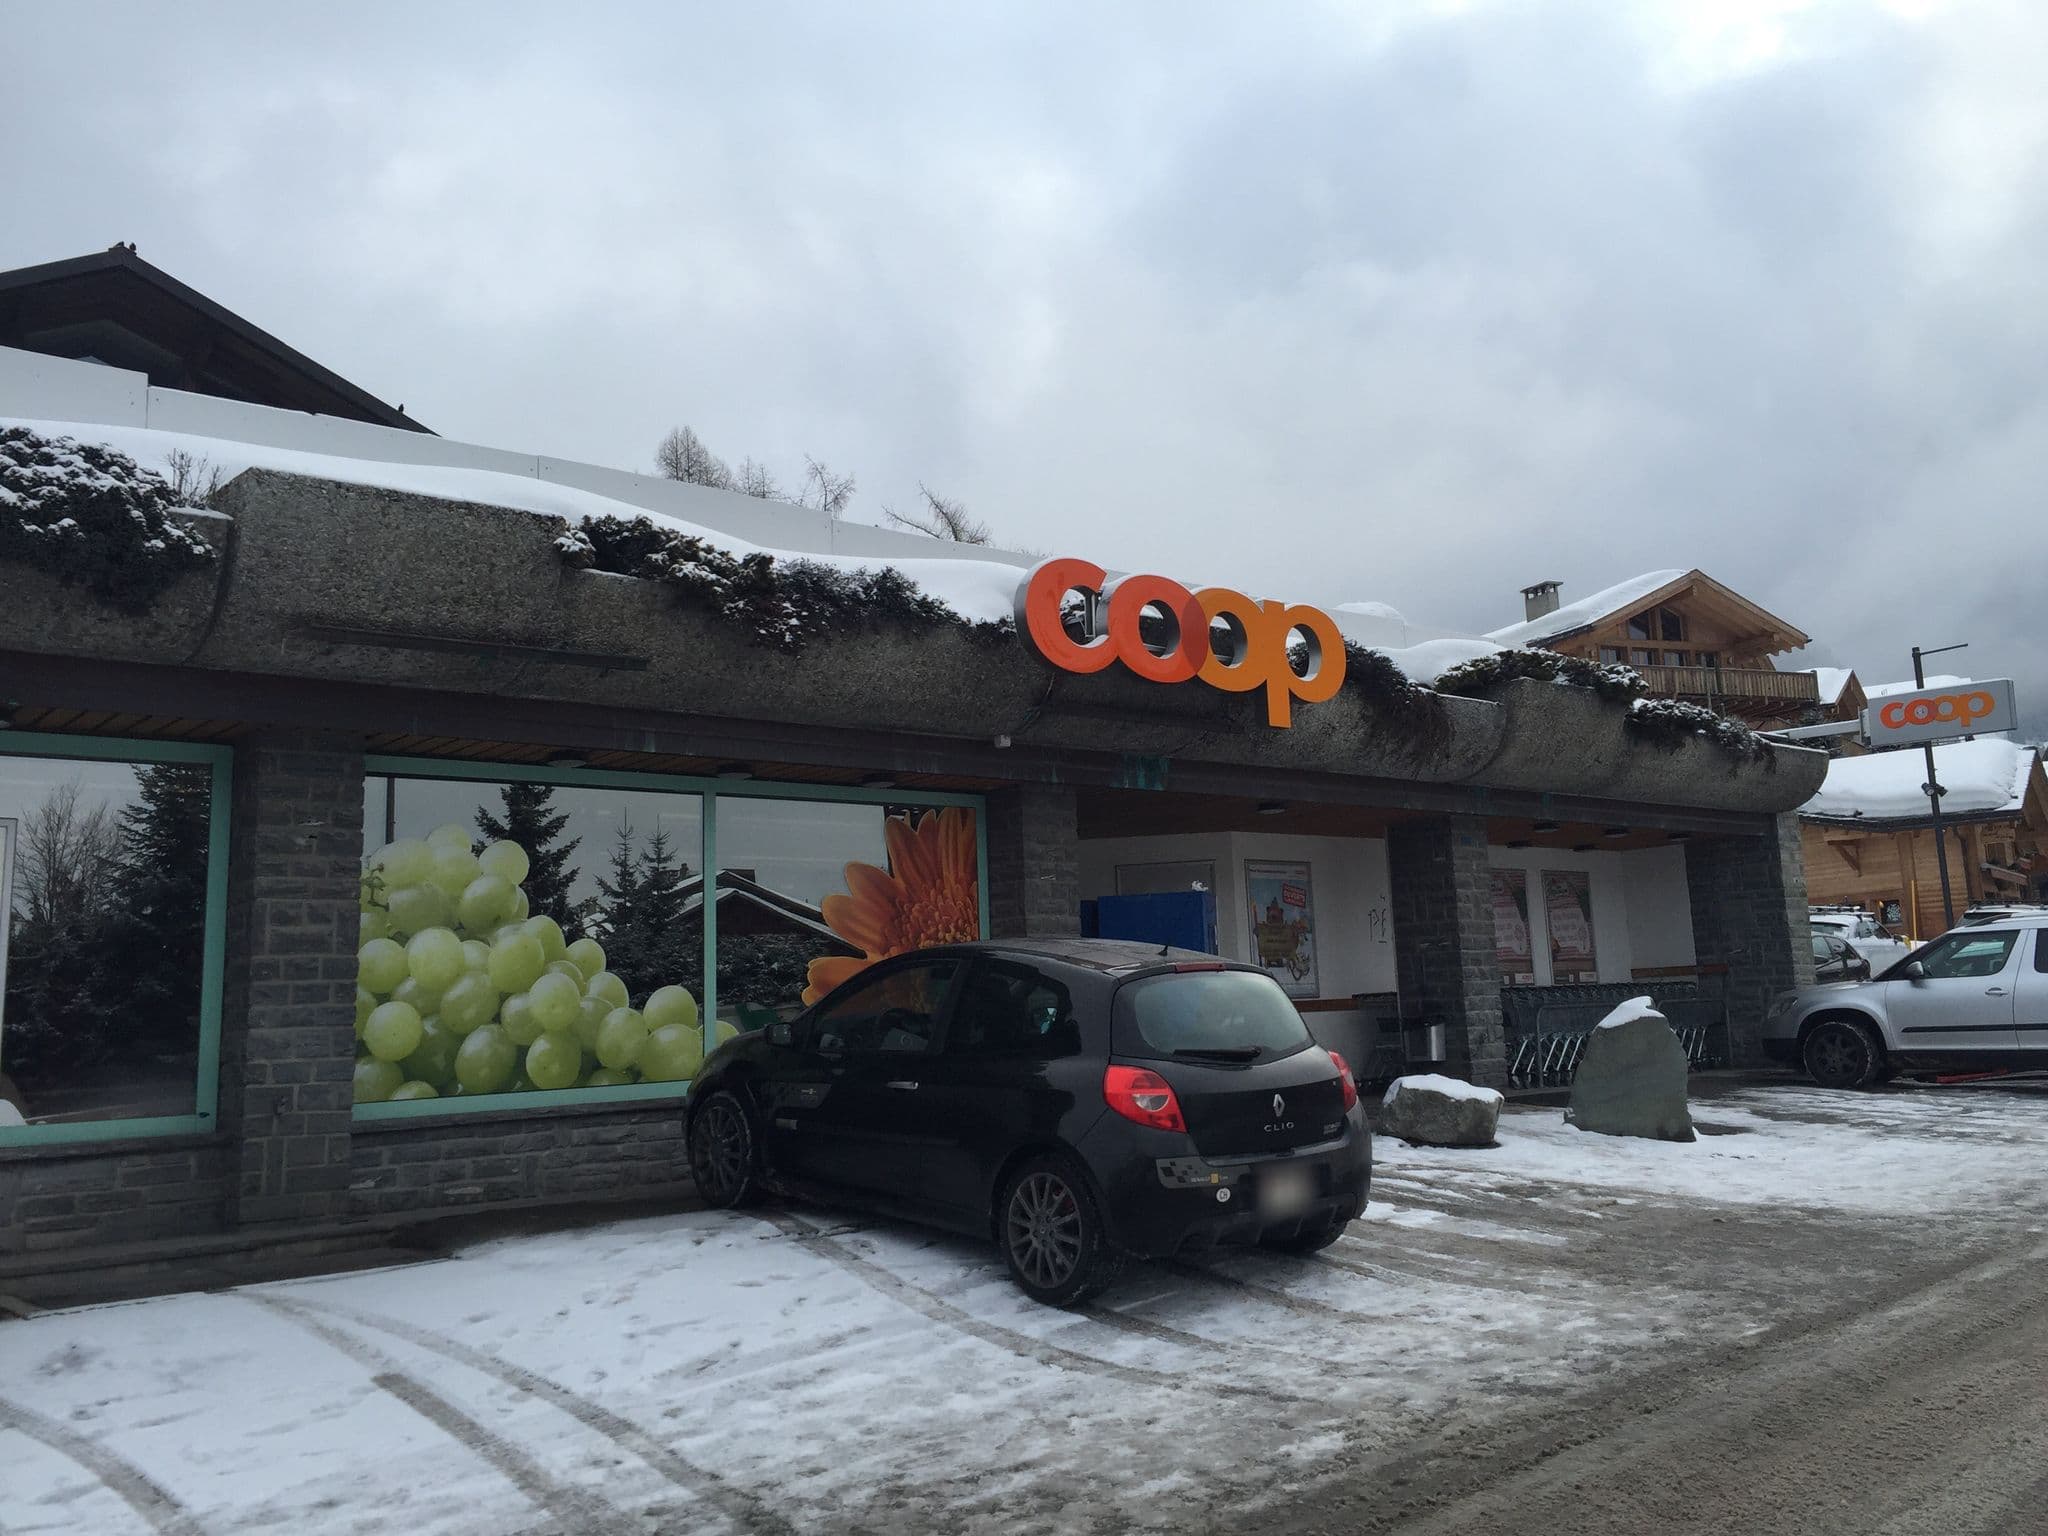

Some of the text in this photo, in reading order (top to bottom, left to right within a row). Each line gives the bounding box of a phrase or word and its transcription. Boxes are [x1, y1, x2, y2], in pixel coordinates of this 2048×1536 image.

[1016, 557, 1347, 729] coop
[1879, 690, 1995, 729] coop
[1263, 1120, 1295, 1133] CLIO
